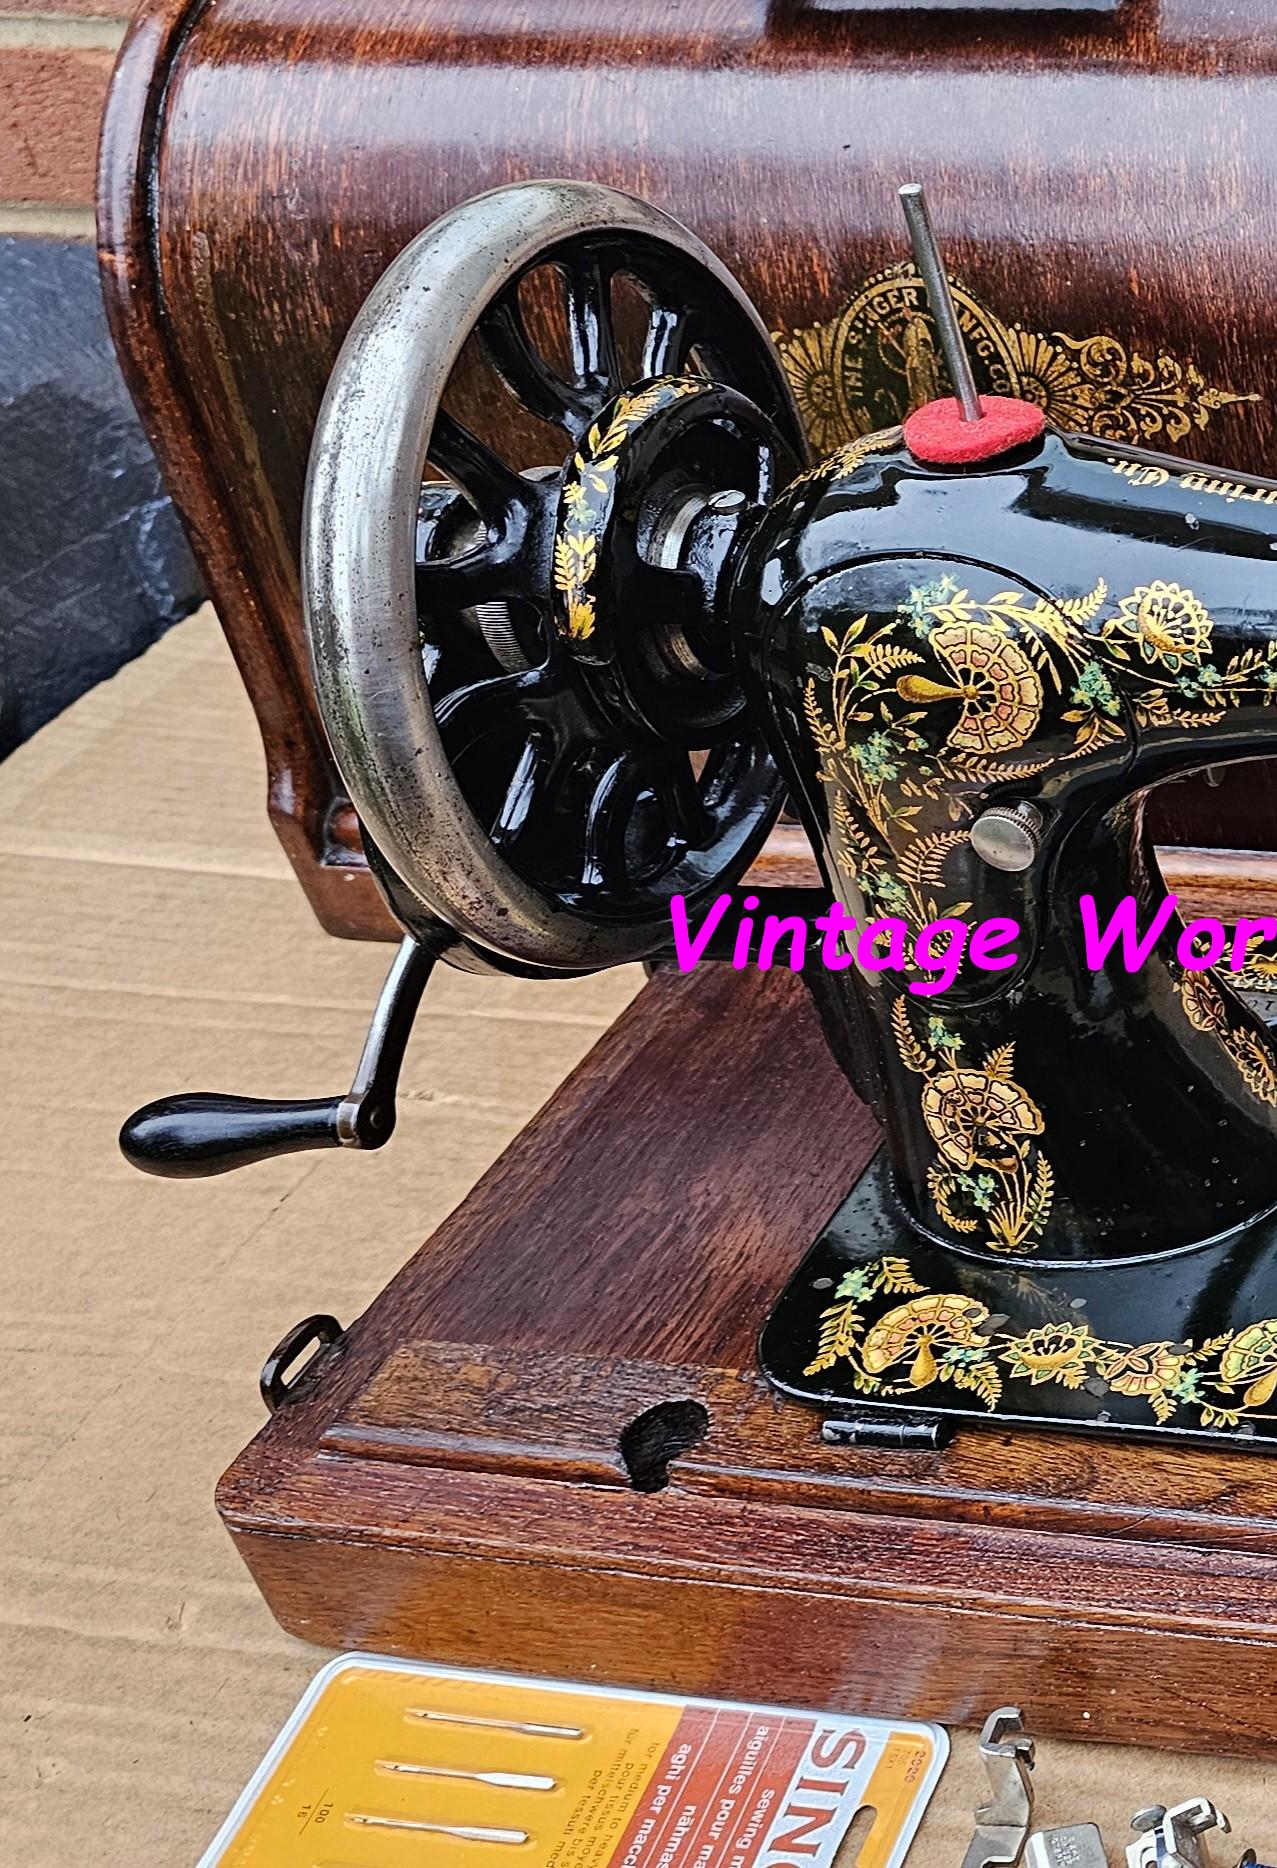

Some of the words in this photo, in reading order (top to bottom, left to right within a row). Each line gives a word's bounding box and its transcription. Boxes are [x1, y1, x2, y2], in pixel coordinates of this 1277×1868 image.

[849, 287, 919, 347] SINGER
[844, 353, 864, 398] THE
[616, 1762, 635, 1790] pour
[664, 1743, 692, 1782] aghi
[728, 1725, 770, 1795] aiguilles
[903, 1750, 927, 1784] 2020
[587, 1769, 603, 1791] per
[618, 1763, 648, 1812] medium
[649, 1783, 673, 1816] per
[765, 1727, 867, 1868] SIN
[314, 1802, 334, 1824] 100
[562, 1795, 592, 1835] tessuti
[593, 1795, 620, 1831] tissus
[609, 1817, 622, 1830] to
[708, 1798, 736, 1841] pour
[735, 1788, 776, 1850] sewing
[566, 1837, 585, 1857] bis
